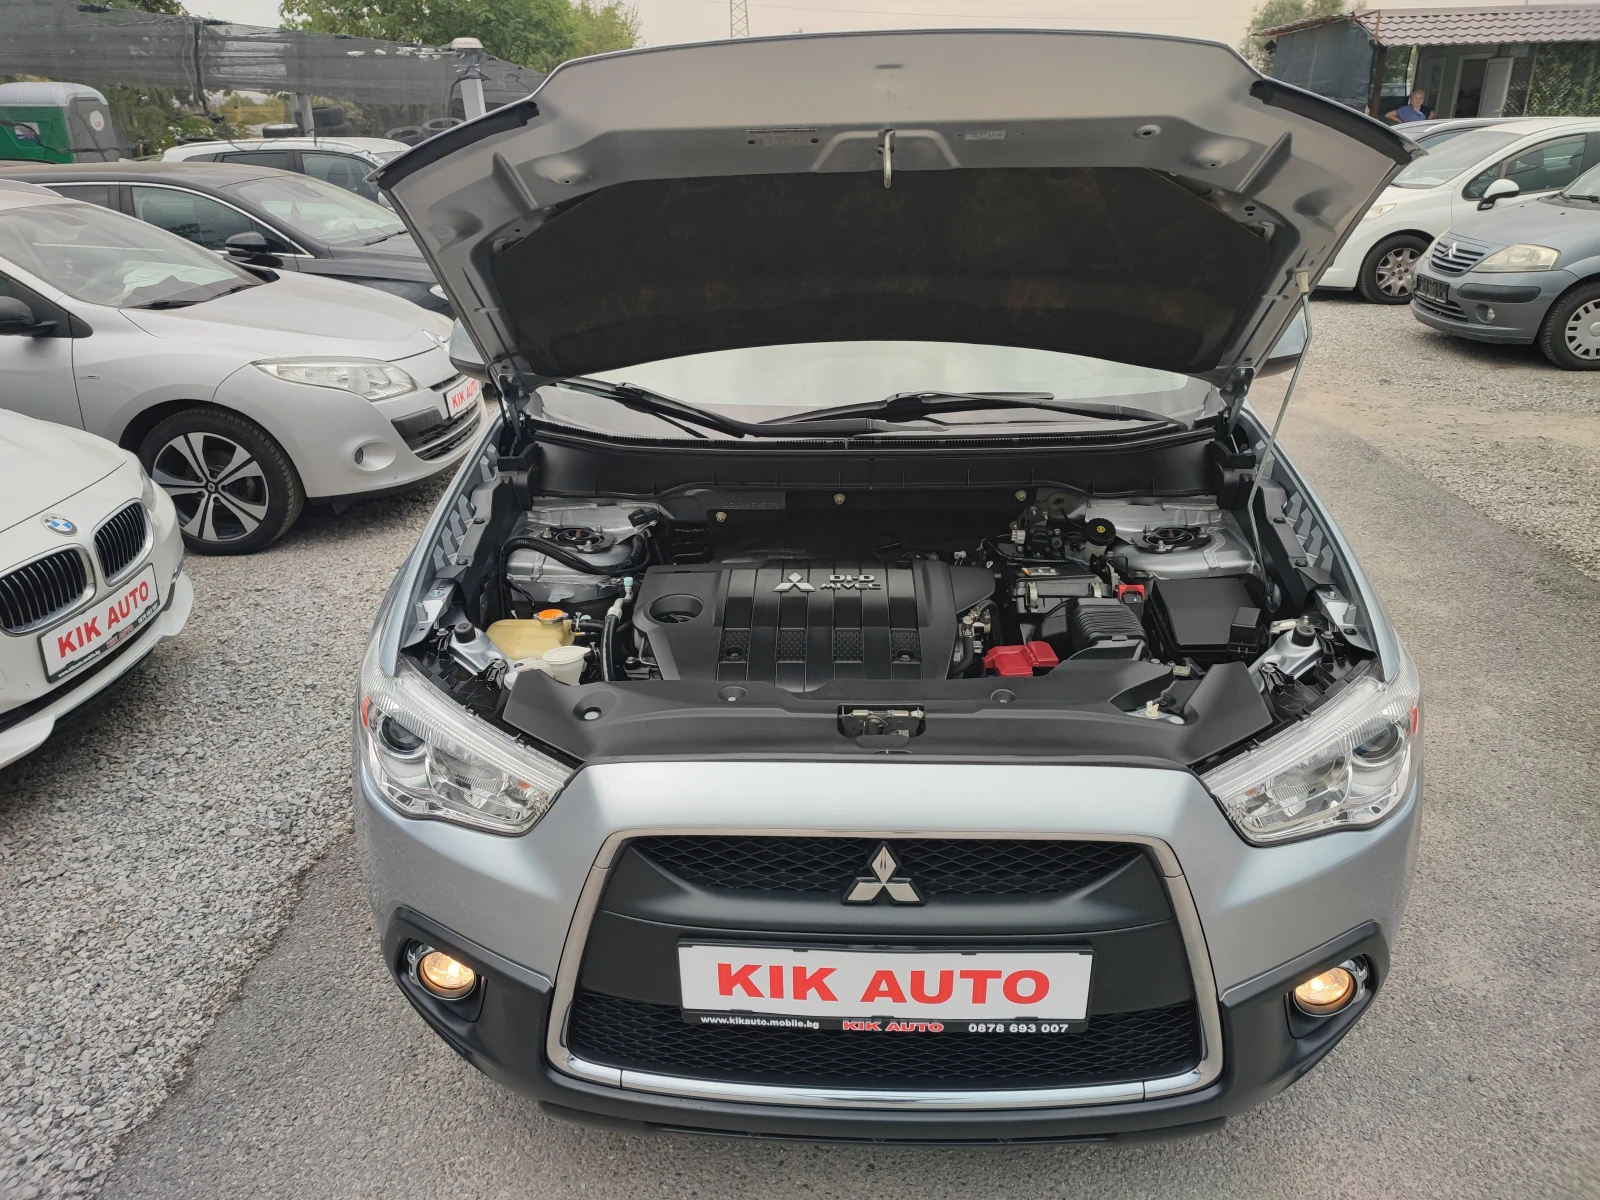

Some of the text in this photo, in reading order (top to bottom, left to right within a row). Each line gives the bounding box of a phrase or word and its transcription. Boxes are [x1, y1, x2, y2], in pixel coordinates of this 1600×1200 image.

[451, 390, 465, 408] KIK
[820, 583, 882, 591] MIVEC
[829, 574, 875, 583] DI-D
[57, 616, 101, 658] KIK
[107, 581, 149, 630] AUTO
[717, 963, 1051, 1005] KIK AUTO
[700, 1015, 1069, 1033] www.kikauto.mobile.bg KIK AUTO 0878 693 007
